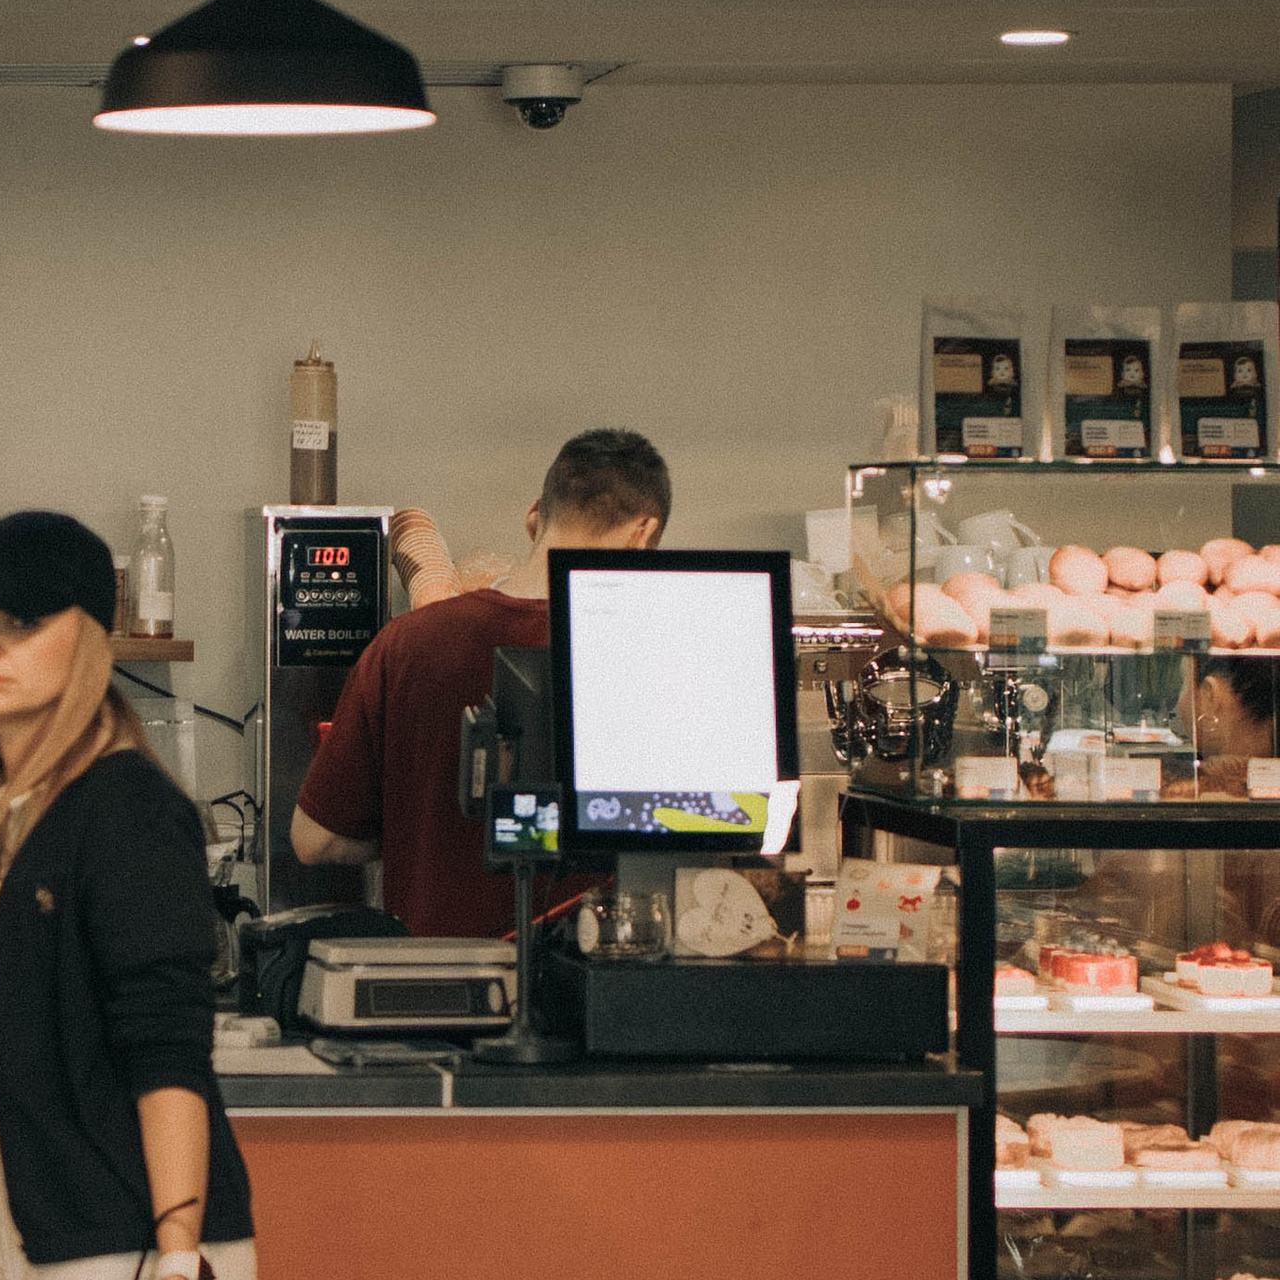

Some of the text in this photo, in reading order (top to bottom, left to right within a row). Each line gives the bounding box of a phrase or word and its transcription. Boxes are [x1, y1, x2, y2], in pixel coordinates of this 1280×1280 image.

[314, 547, 349, 565] 100
[284, 629, 371, 640] WATER BOILER
